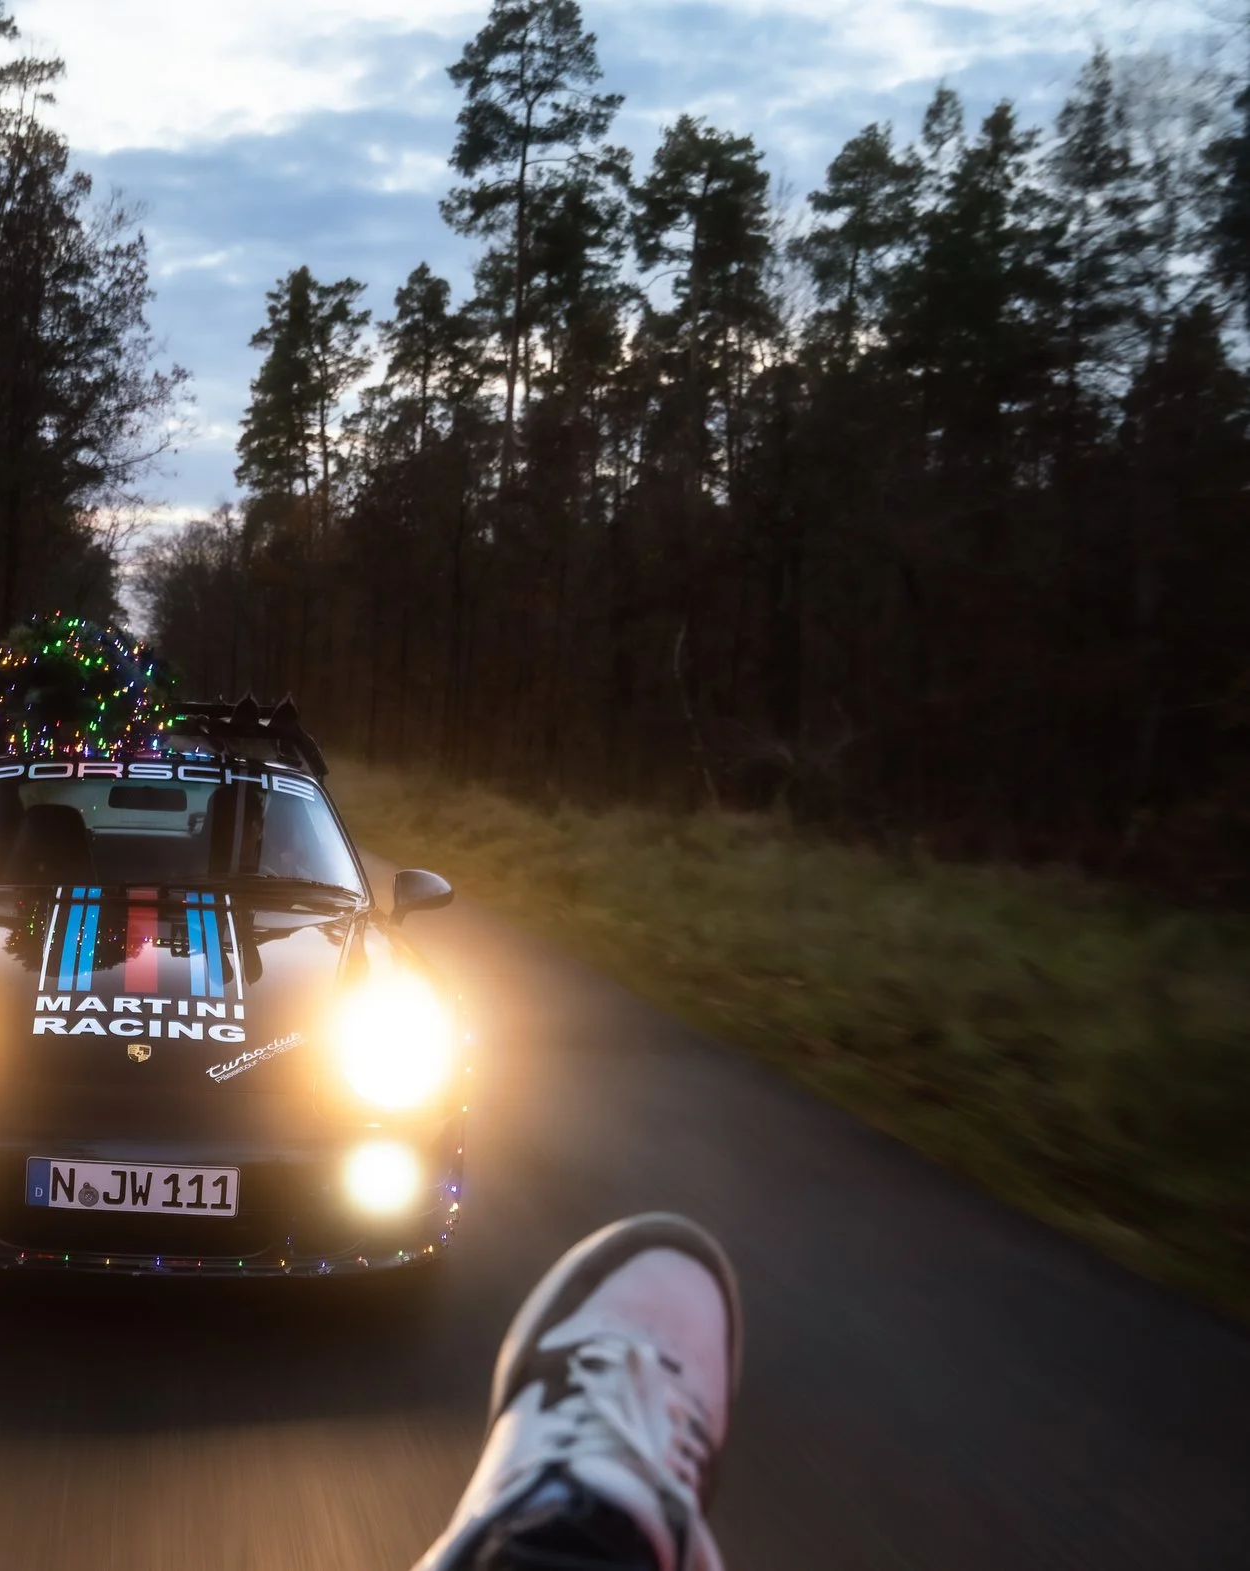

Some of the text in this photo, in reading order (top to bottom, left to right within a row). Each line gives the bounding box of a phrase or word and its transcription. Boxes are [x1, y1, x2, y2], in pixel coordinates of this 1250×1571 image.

[34, 996, 245, 1020] MARTINI
[32, 1017, 246, 1043] RACING
[34, 1186, 44, 1198] D
[51, 1166, 232, 1210] N JW 111
